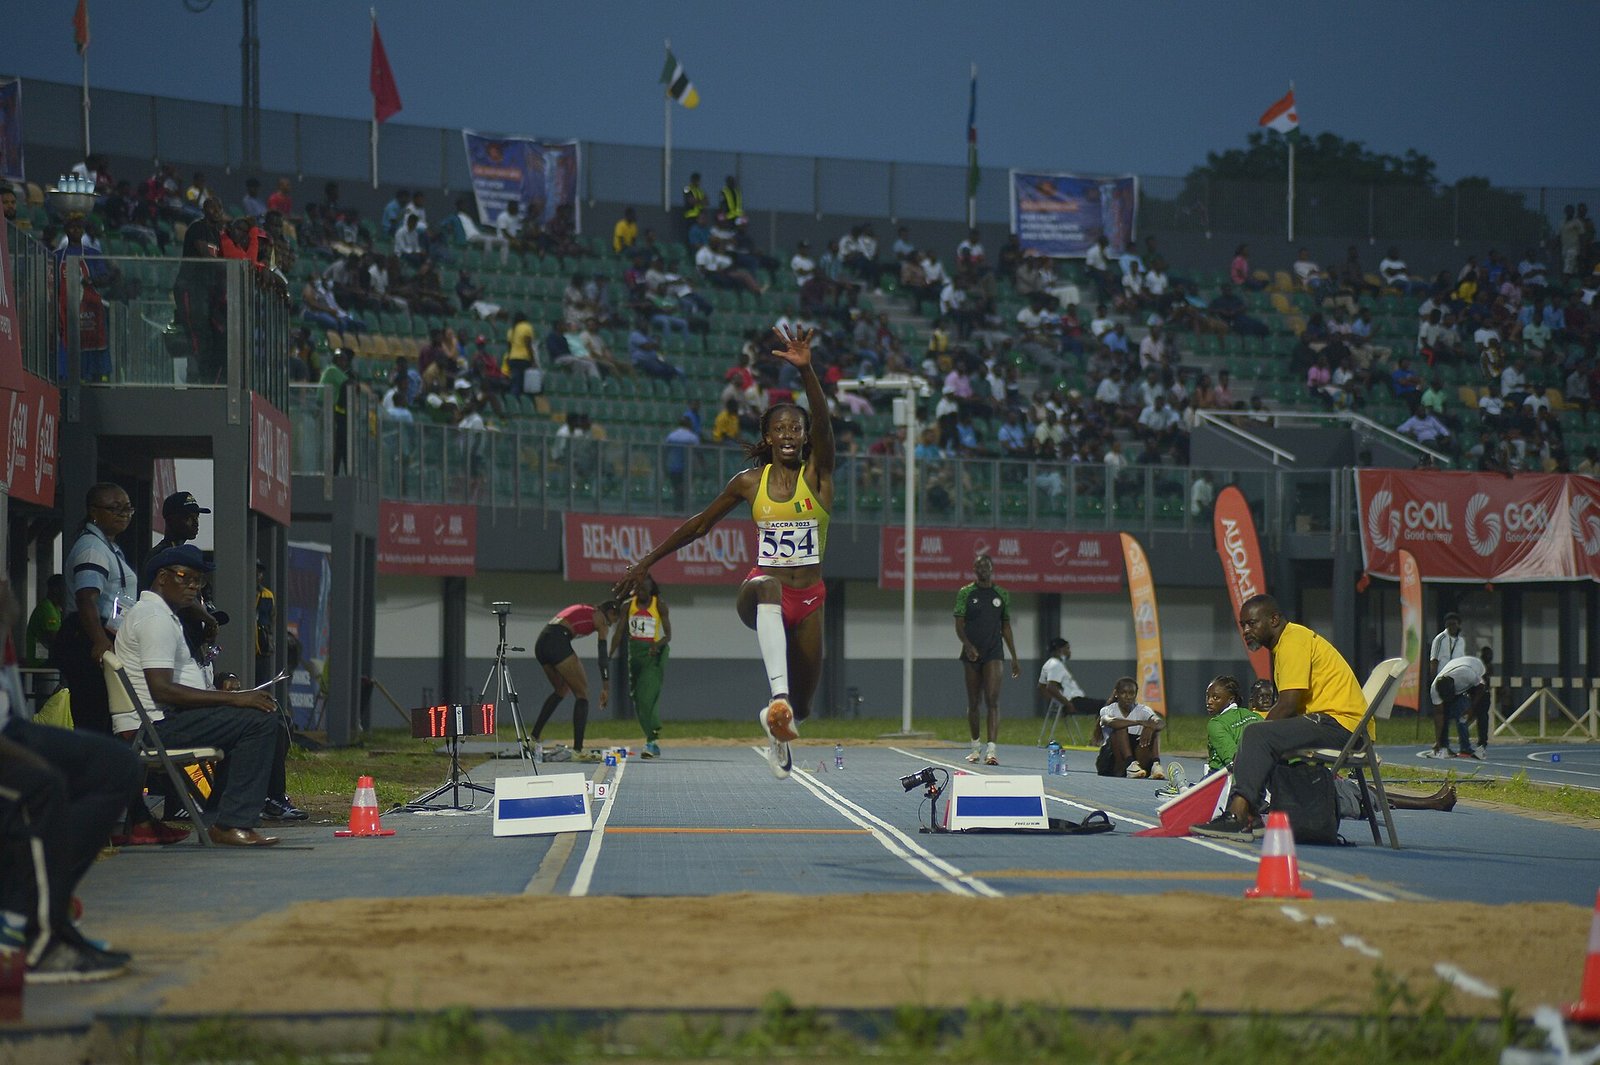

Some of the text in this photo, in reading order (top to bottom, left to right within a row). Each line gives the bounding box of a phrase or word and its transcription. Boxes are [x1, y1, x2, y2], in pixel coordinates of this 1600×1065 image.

[1404, 500, 1452, 530] GOIL
[762, 529, 814, 558] 554
[1077, 540, 1101, 559] AWA
[1404, 529, 1425, 541] Good
[428, 706, 448, 737] 17
[481, 704, 495, 735] 17
[598, 786, 605, 795] 9
